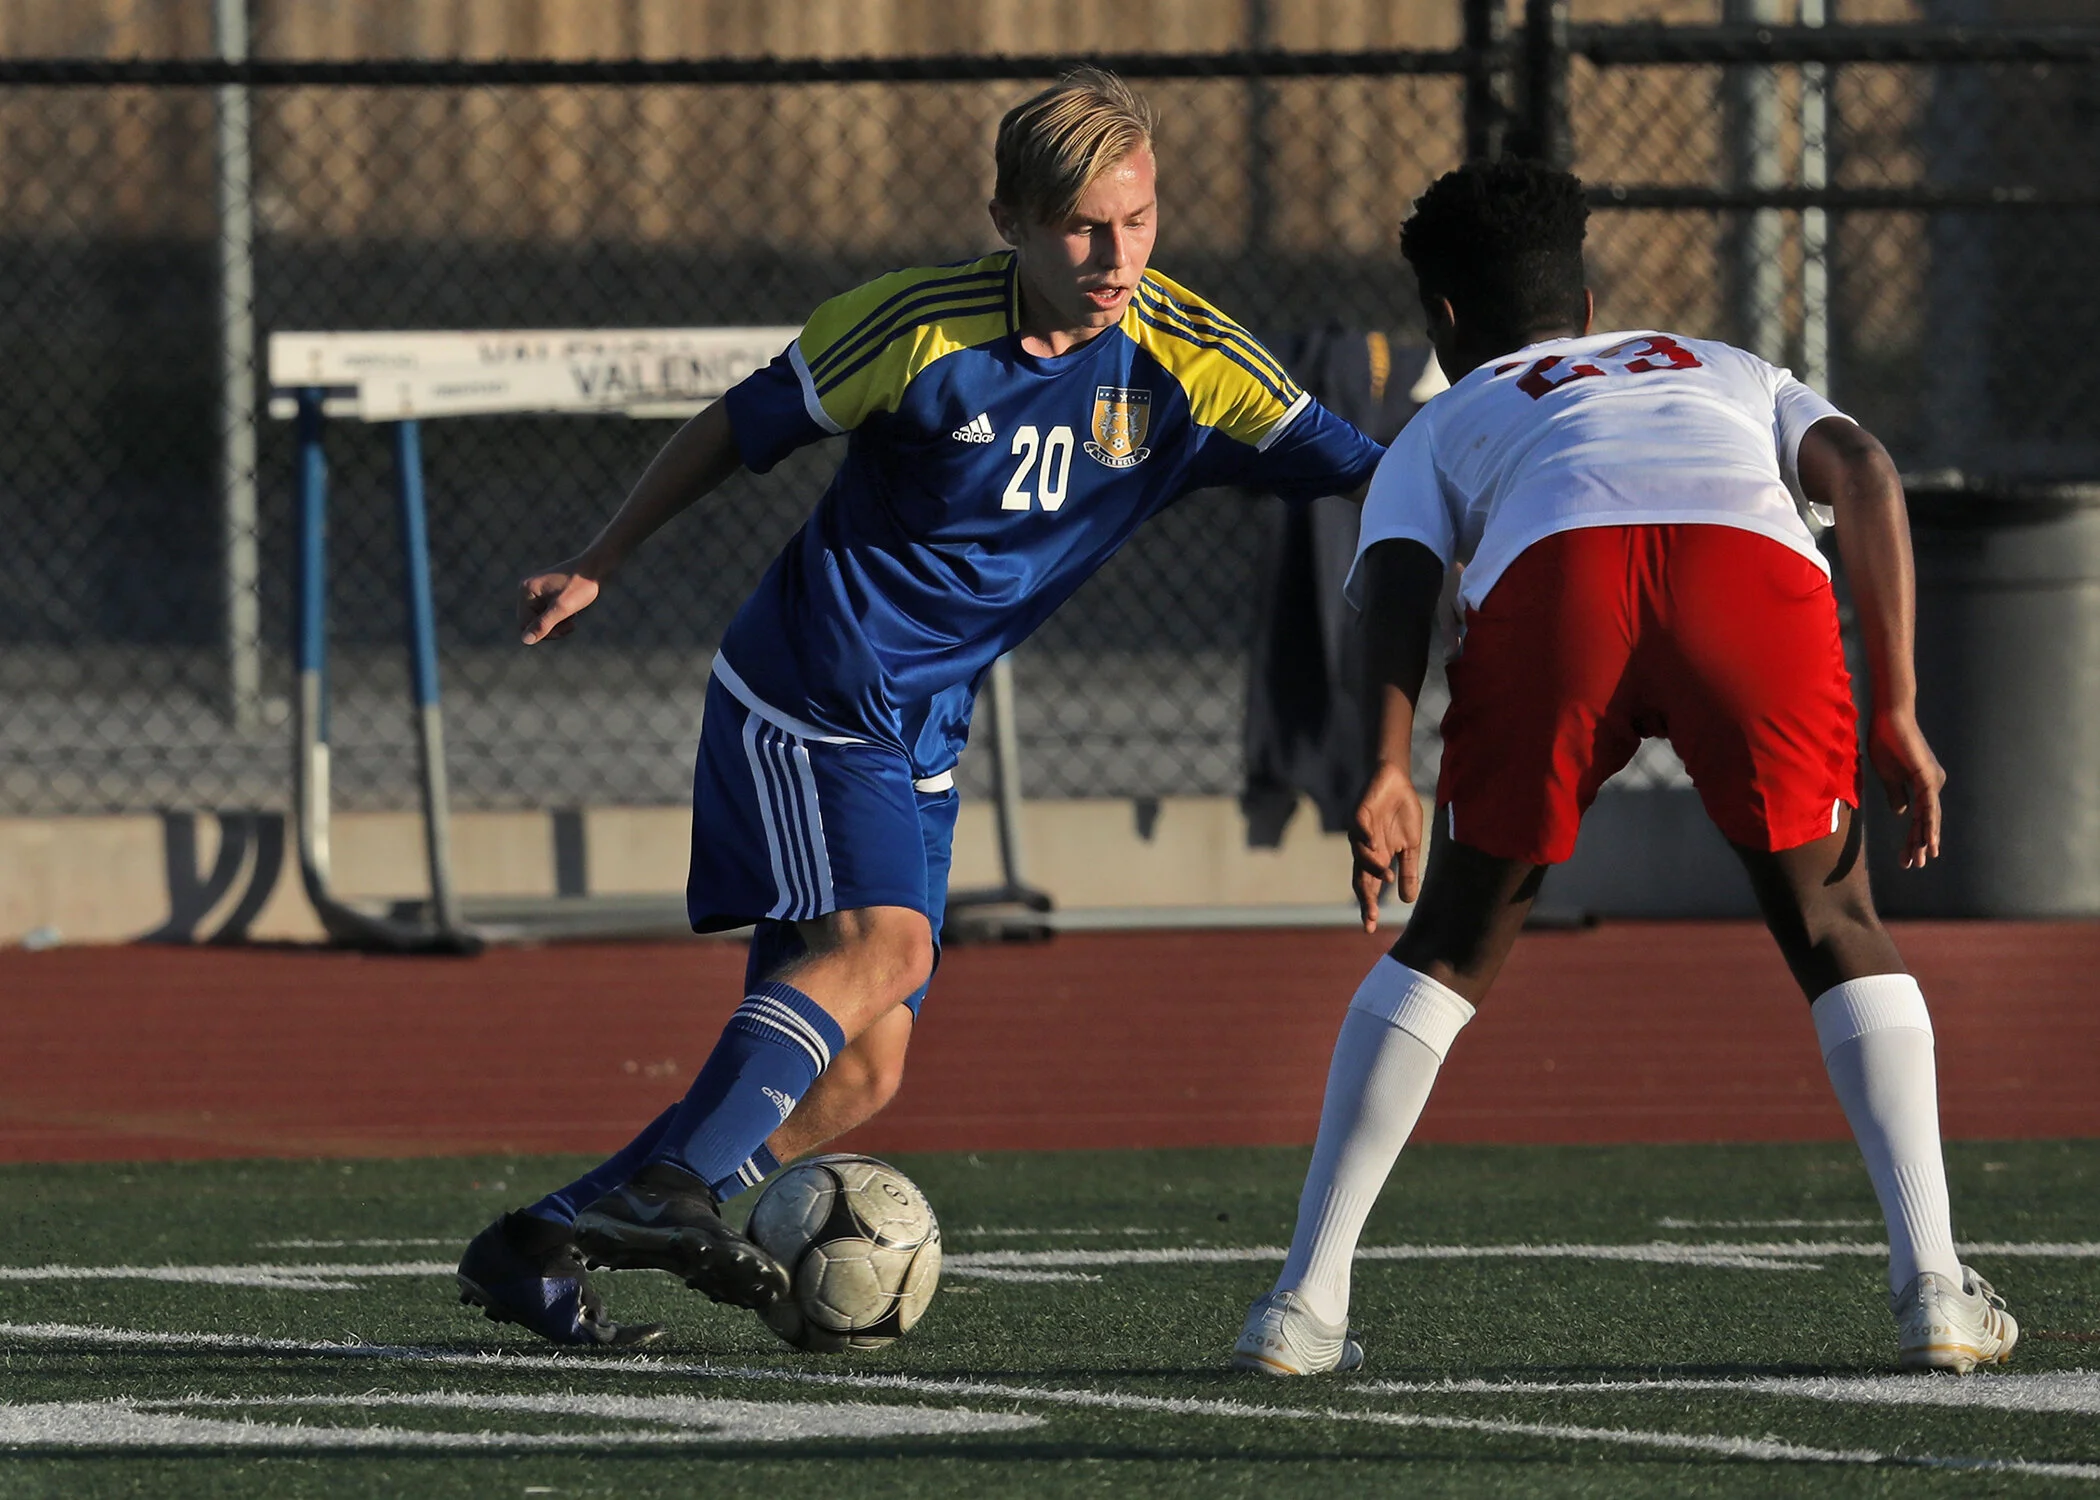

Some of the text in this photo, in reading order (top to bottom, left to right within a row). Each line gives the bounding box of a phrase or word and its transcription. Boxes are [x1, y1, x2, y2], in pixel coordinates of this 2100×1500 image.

[952, 431, 996, 443] adidas
[1096, 451, 1137, 466] VALENCIA
[1001, 425, 1075, 512] 20
[1911, 1325, 1952, 1337] COPA
[1246, 1332, 1285, 1353] COPA
